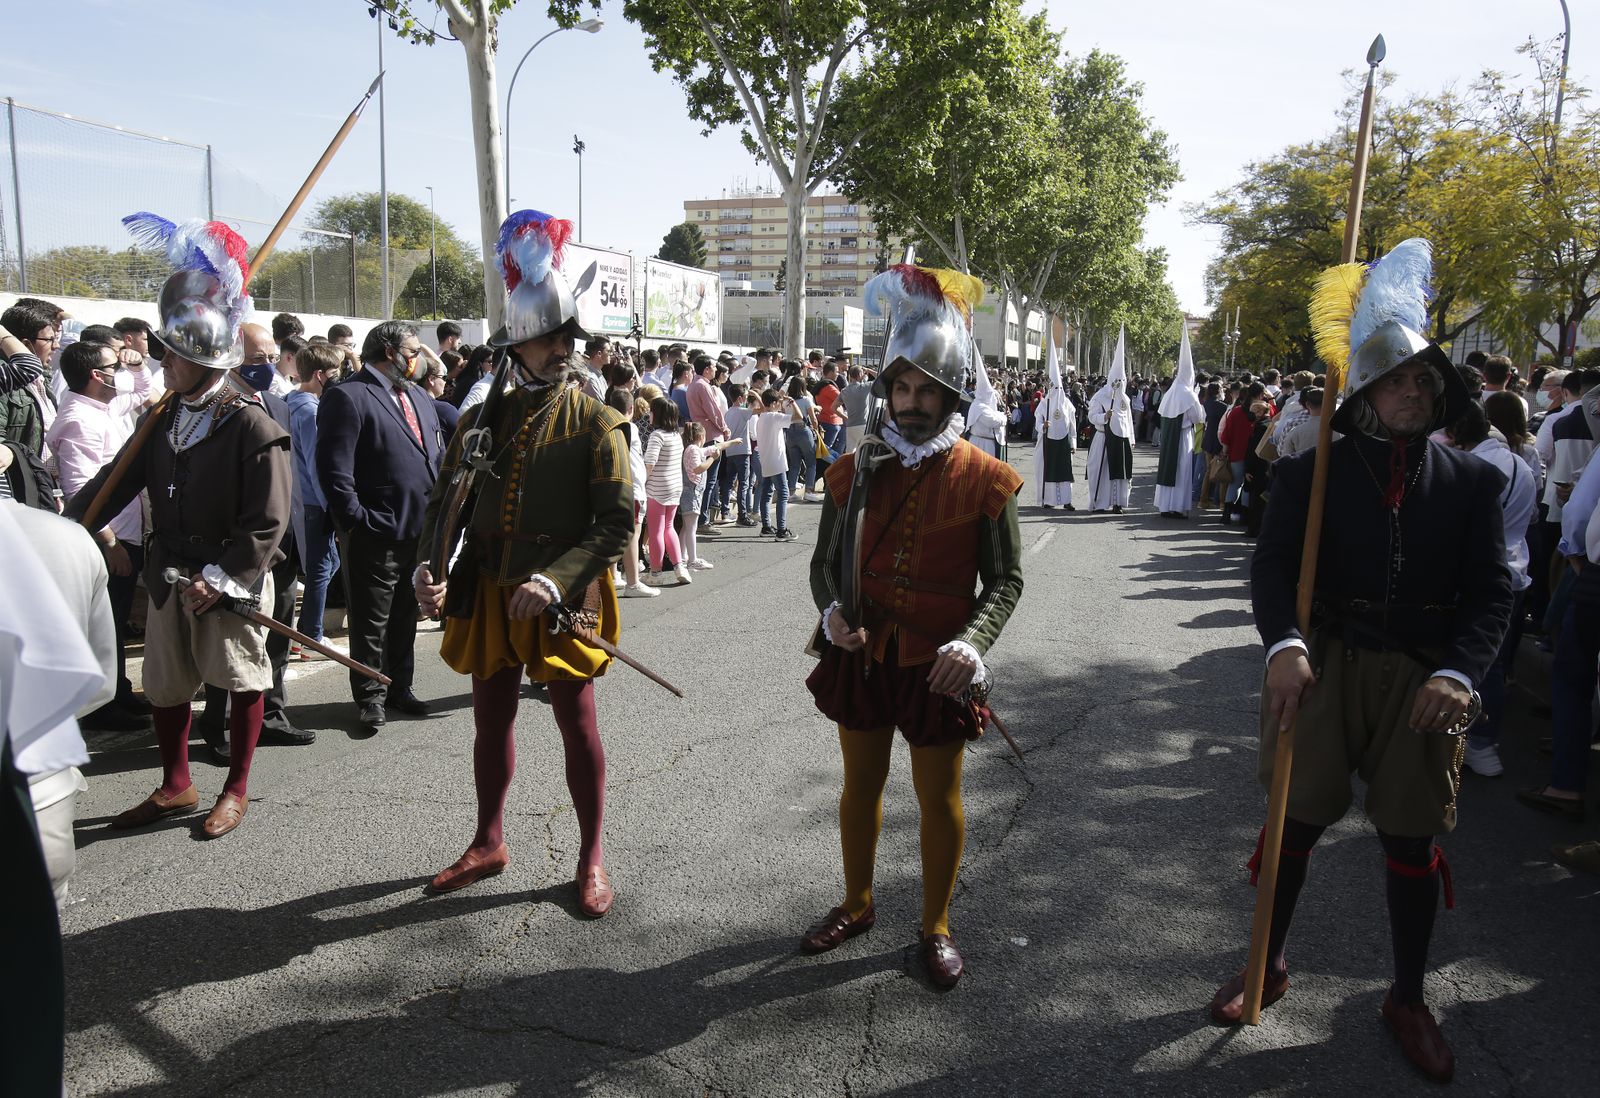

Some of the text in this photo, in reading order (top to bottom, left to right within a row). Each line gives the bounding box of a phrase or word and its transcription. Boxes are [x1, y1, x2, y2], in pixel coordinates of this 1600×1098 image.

[600, 264, 608, 272] NIKE
[613, 267, 627, 275] ADIDAS
[600, 281, 625, 307] 54 €
[619, 298, 627, 308] 99
[605, 316, 627, 327] Sprinter
